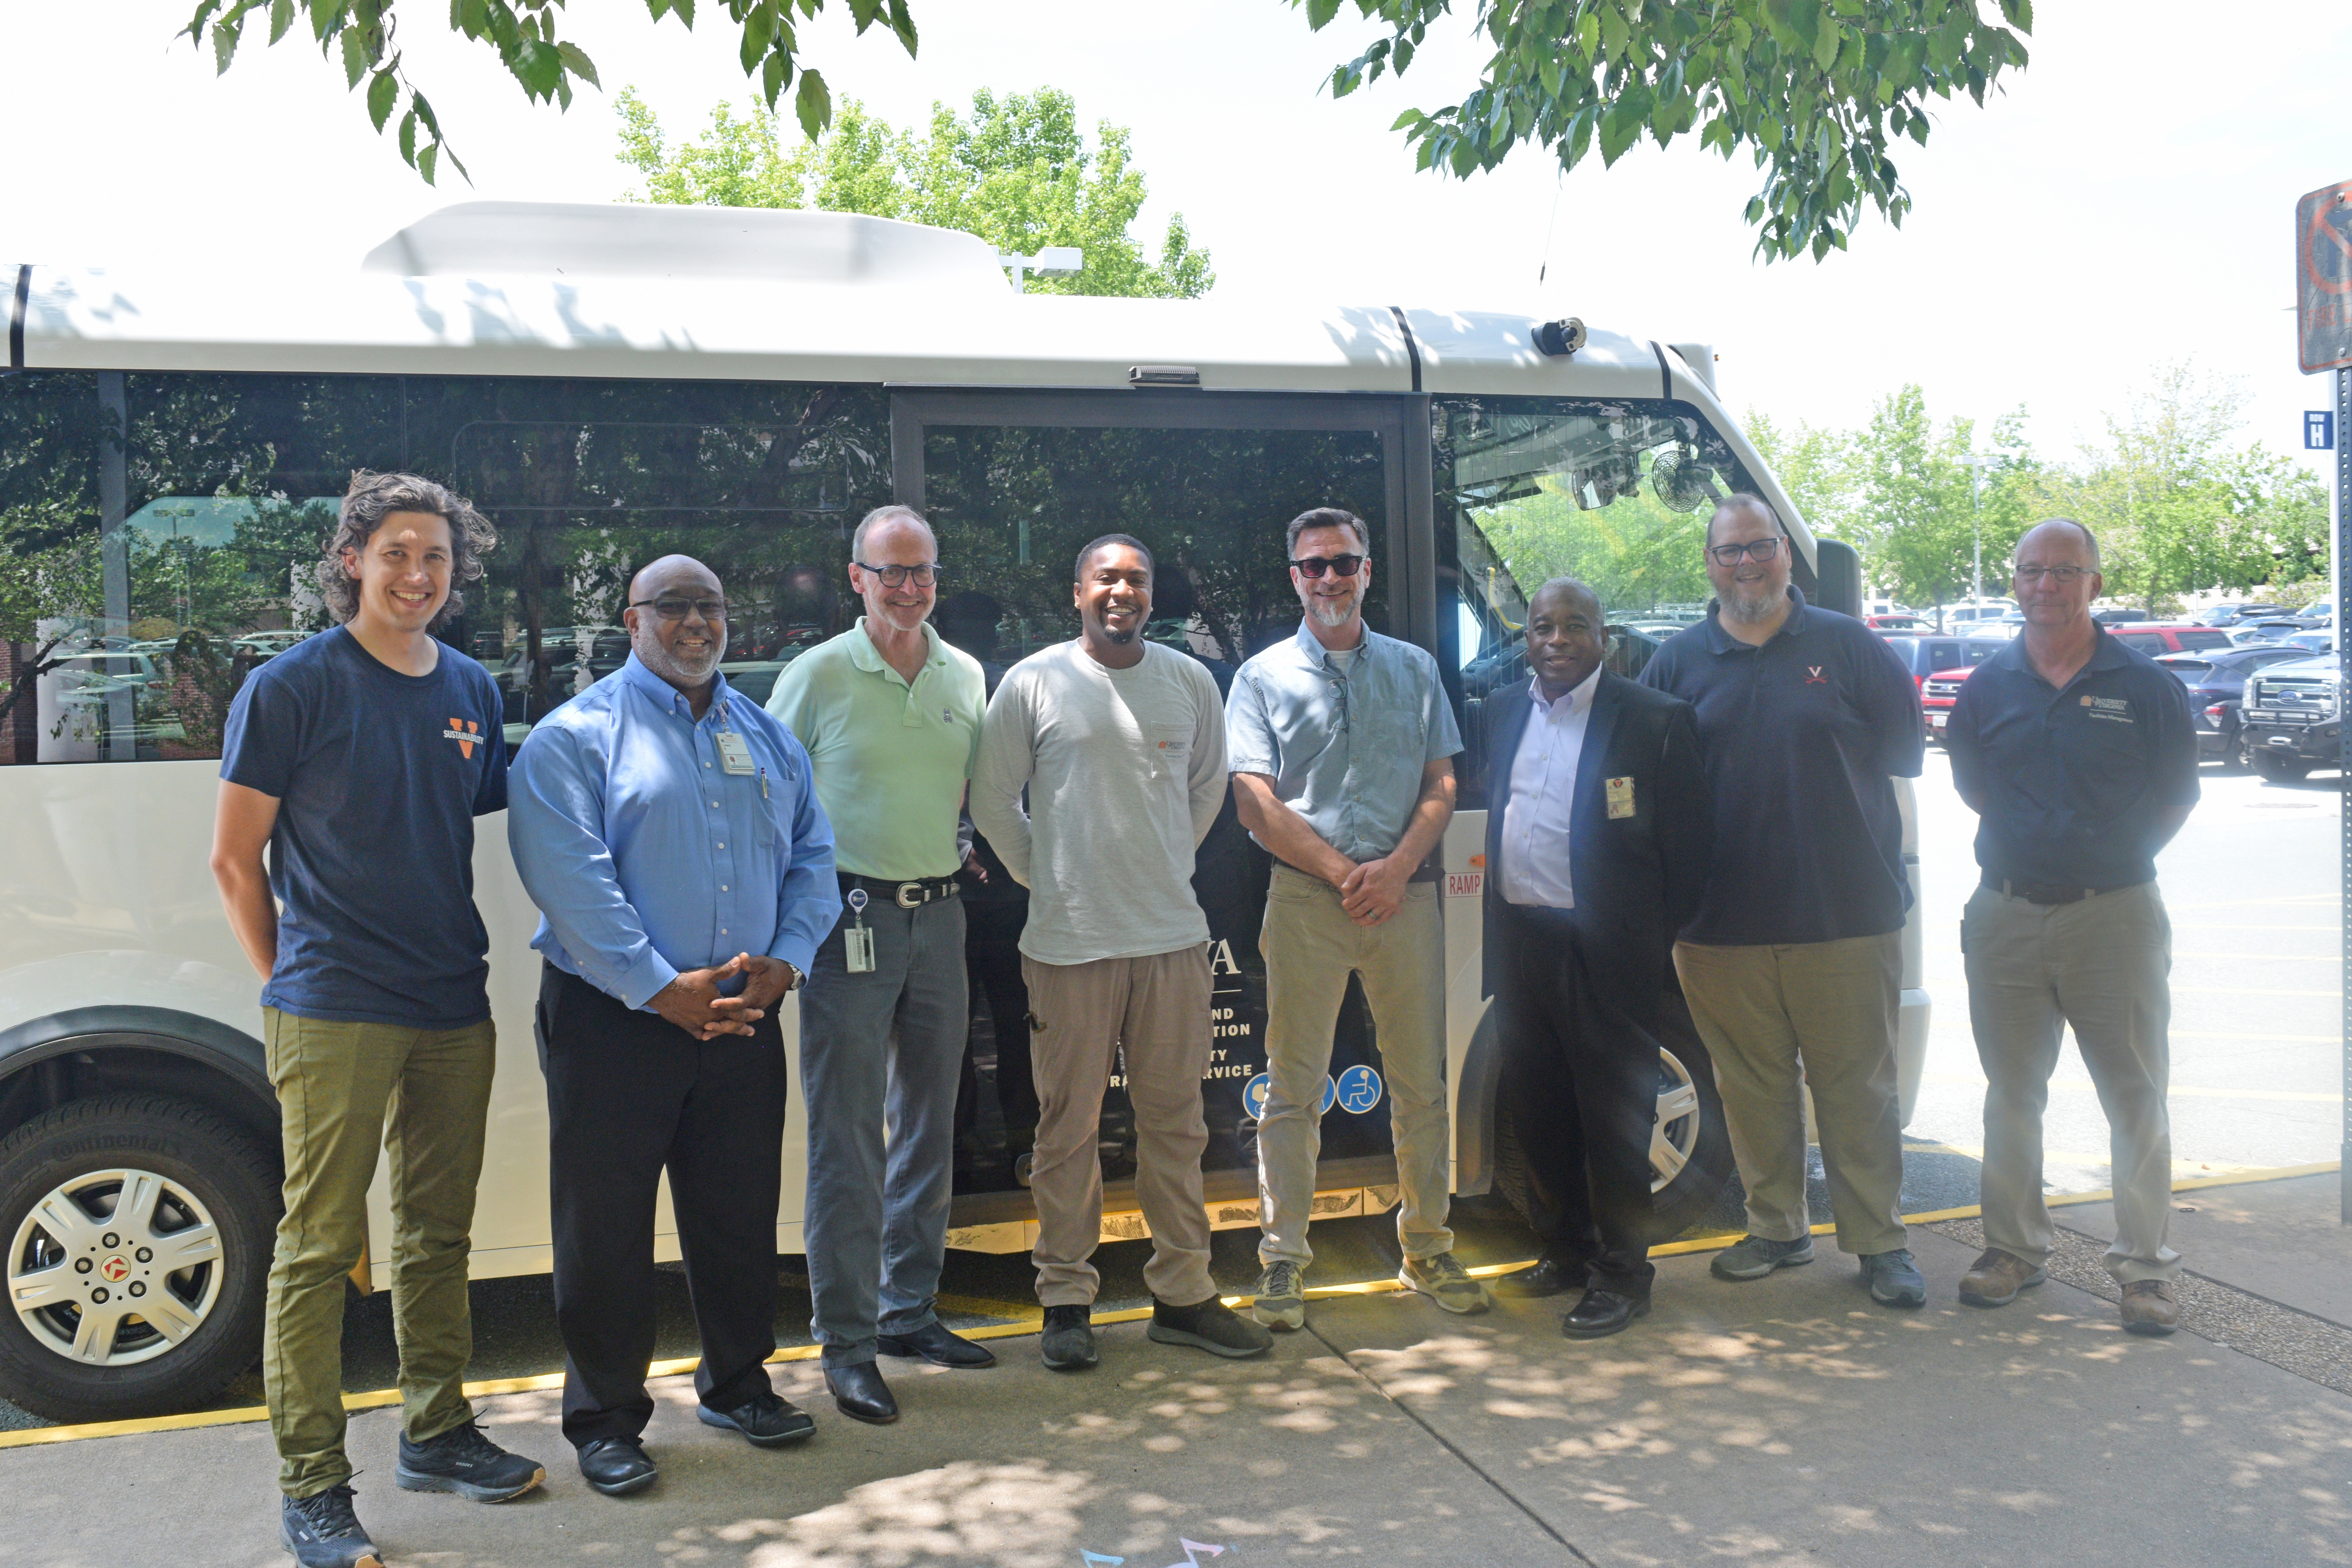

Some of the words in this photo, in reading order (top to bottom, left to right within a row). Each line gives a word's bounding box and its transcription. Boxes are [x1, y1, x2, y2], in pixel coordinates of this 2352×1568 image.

[2308, 304, 2337, 331] FIRE
[2344, 301, 2352, 322] L
[2310, 424, 2324, 446] H
[443, 730, 484, 744] SUSTAINABILITY
[1450, 875, 1480, 895] RAMP
[1212, 1008, 1234, 1020] ND
[1213, 1024, 1250, 1037] TION
[1210, 1049, 1227, 1062] TY
[1203, 1065, 1252, 1079] RVICE
